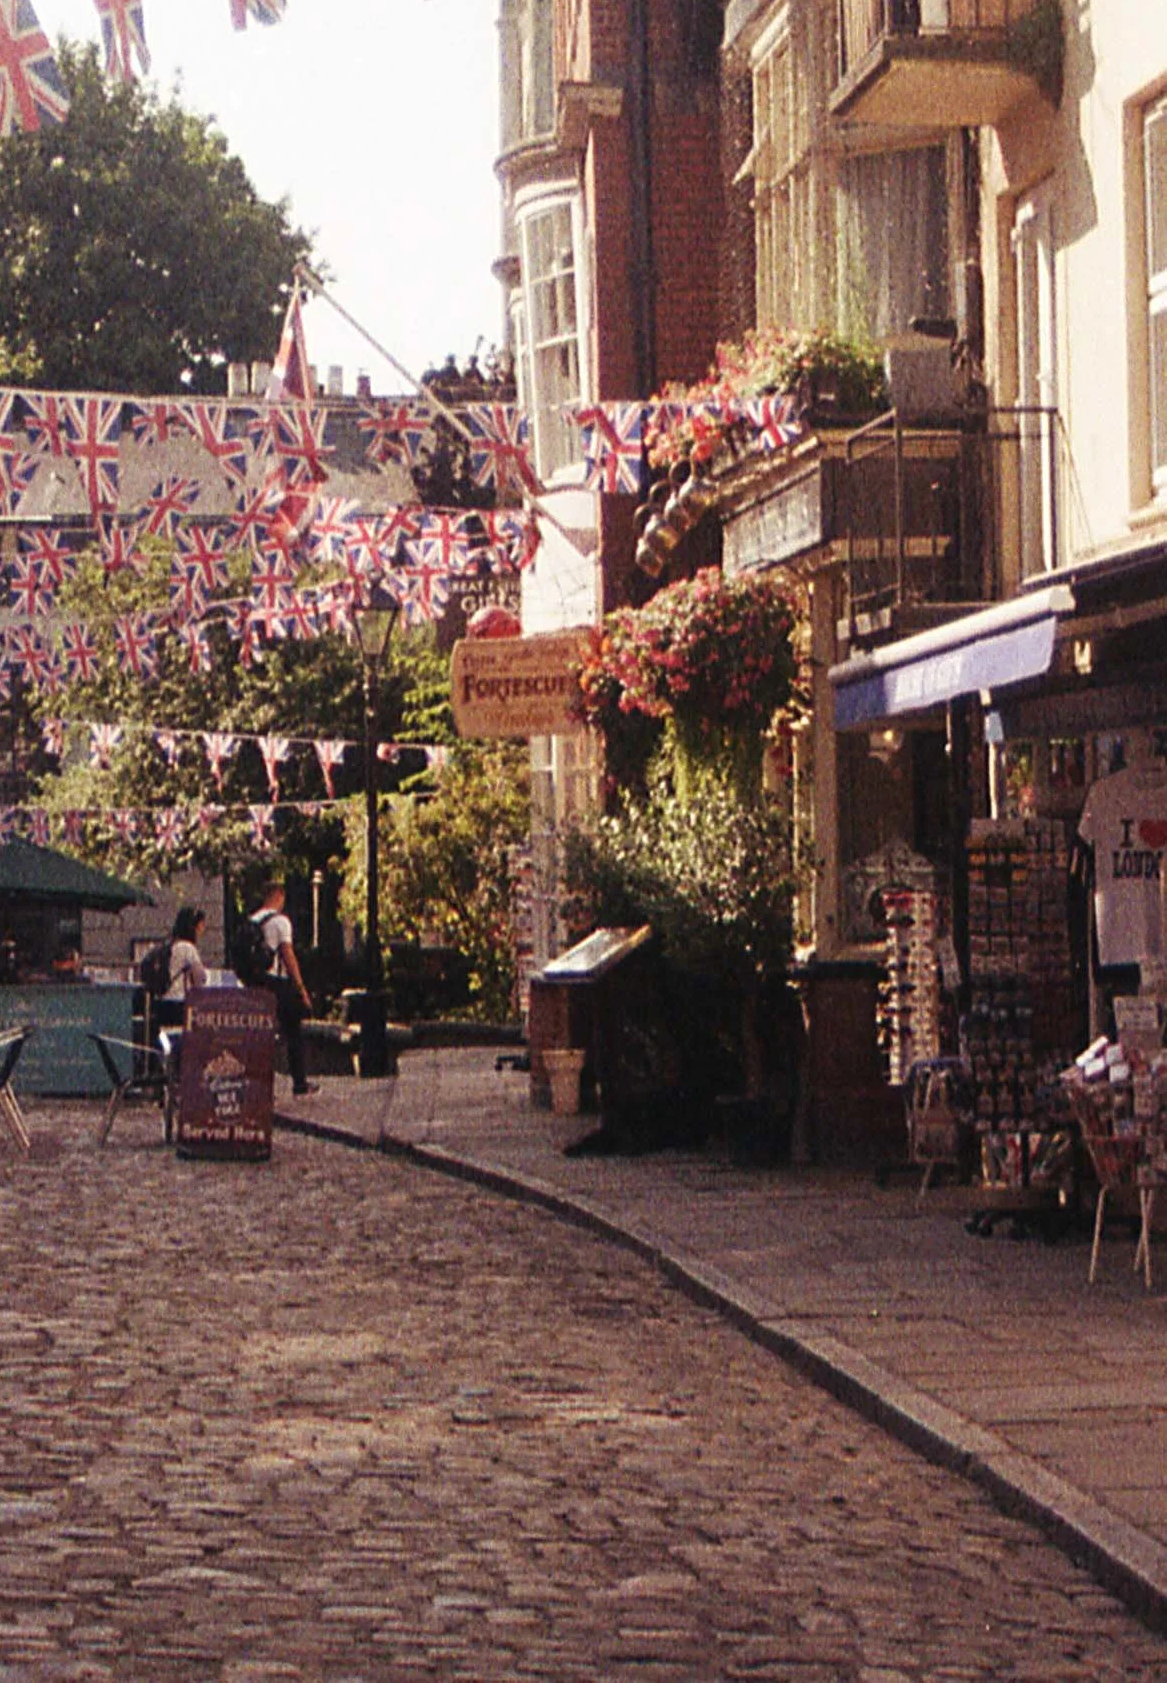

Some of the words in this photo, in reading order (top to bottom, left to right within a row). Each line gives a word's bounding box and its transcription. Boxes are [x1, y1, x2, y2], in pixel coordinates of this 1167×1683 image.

[461, 673, 572, 705] FORTESCUE
[1120, 818, 1134, 847] I
[186, 1006, 274, 1032] FORTESCUES
